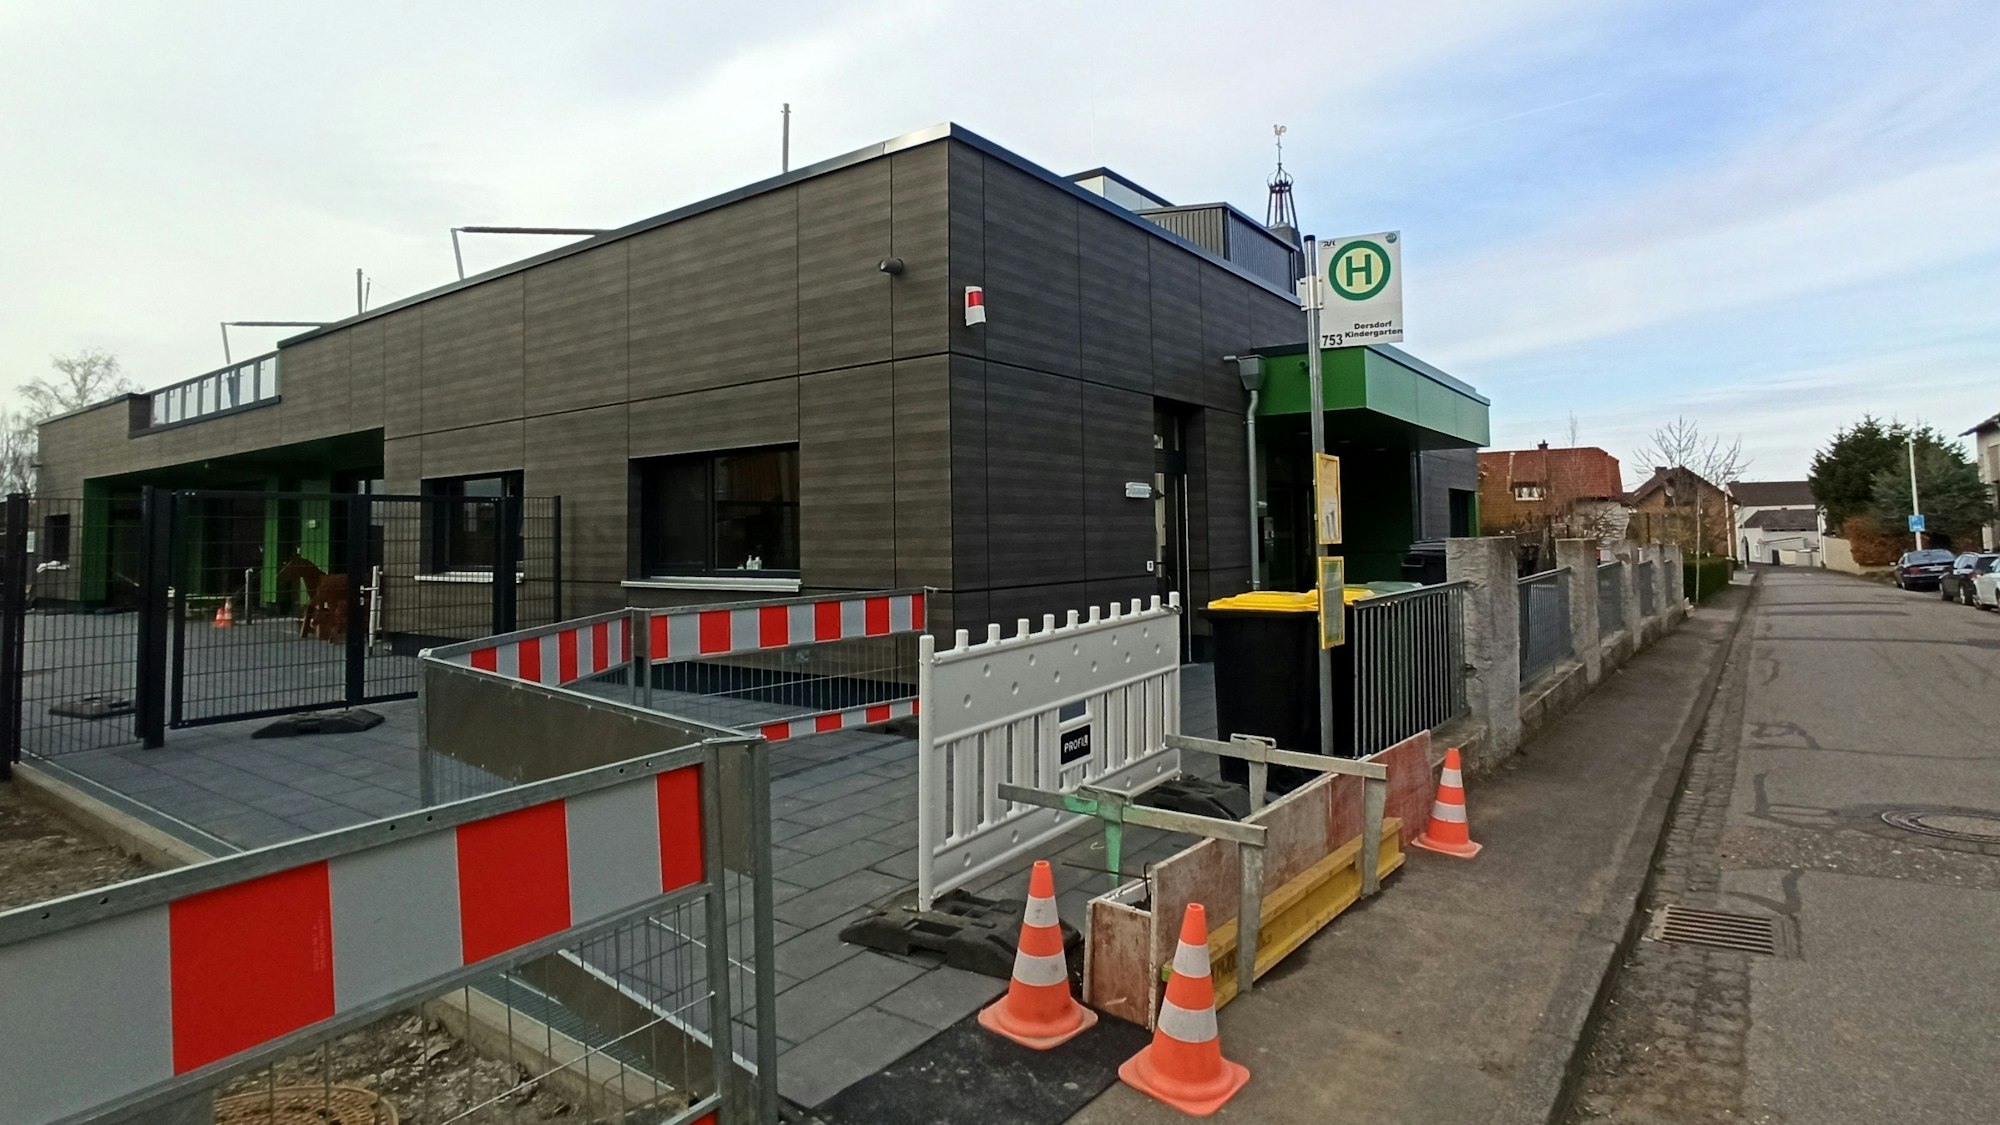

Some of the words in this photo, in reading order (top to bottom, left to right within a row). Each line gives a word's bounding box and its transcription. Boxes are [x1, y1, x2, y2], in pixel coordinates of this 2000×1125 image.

[1345, 254, 1372, 287] H
[1354, 321, 1392, 330] Dersdorf
[1345, 329, 1403, 338] Kindergarten
[1322, 334, 1343, 347] 753
